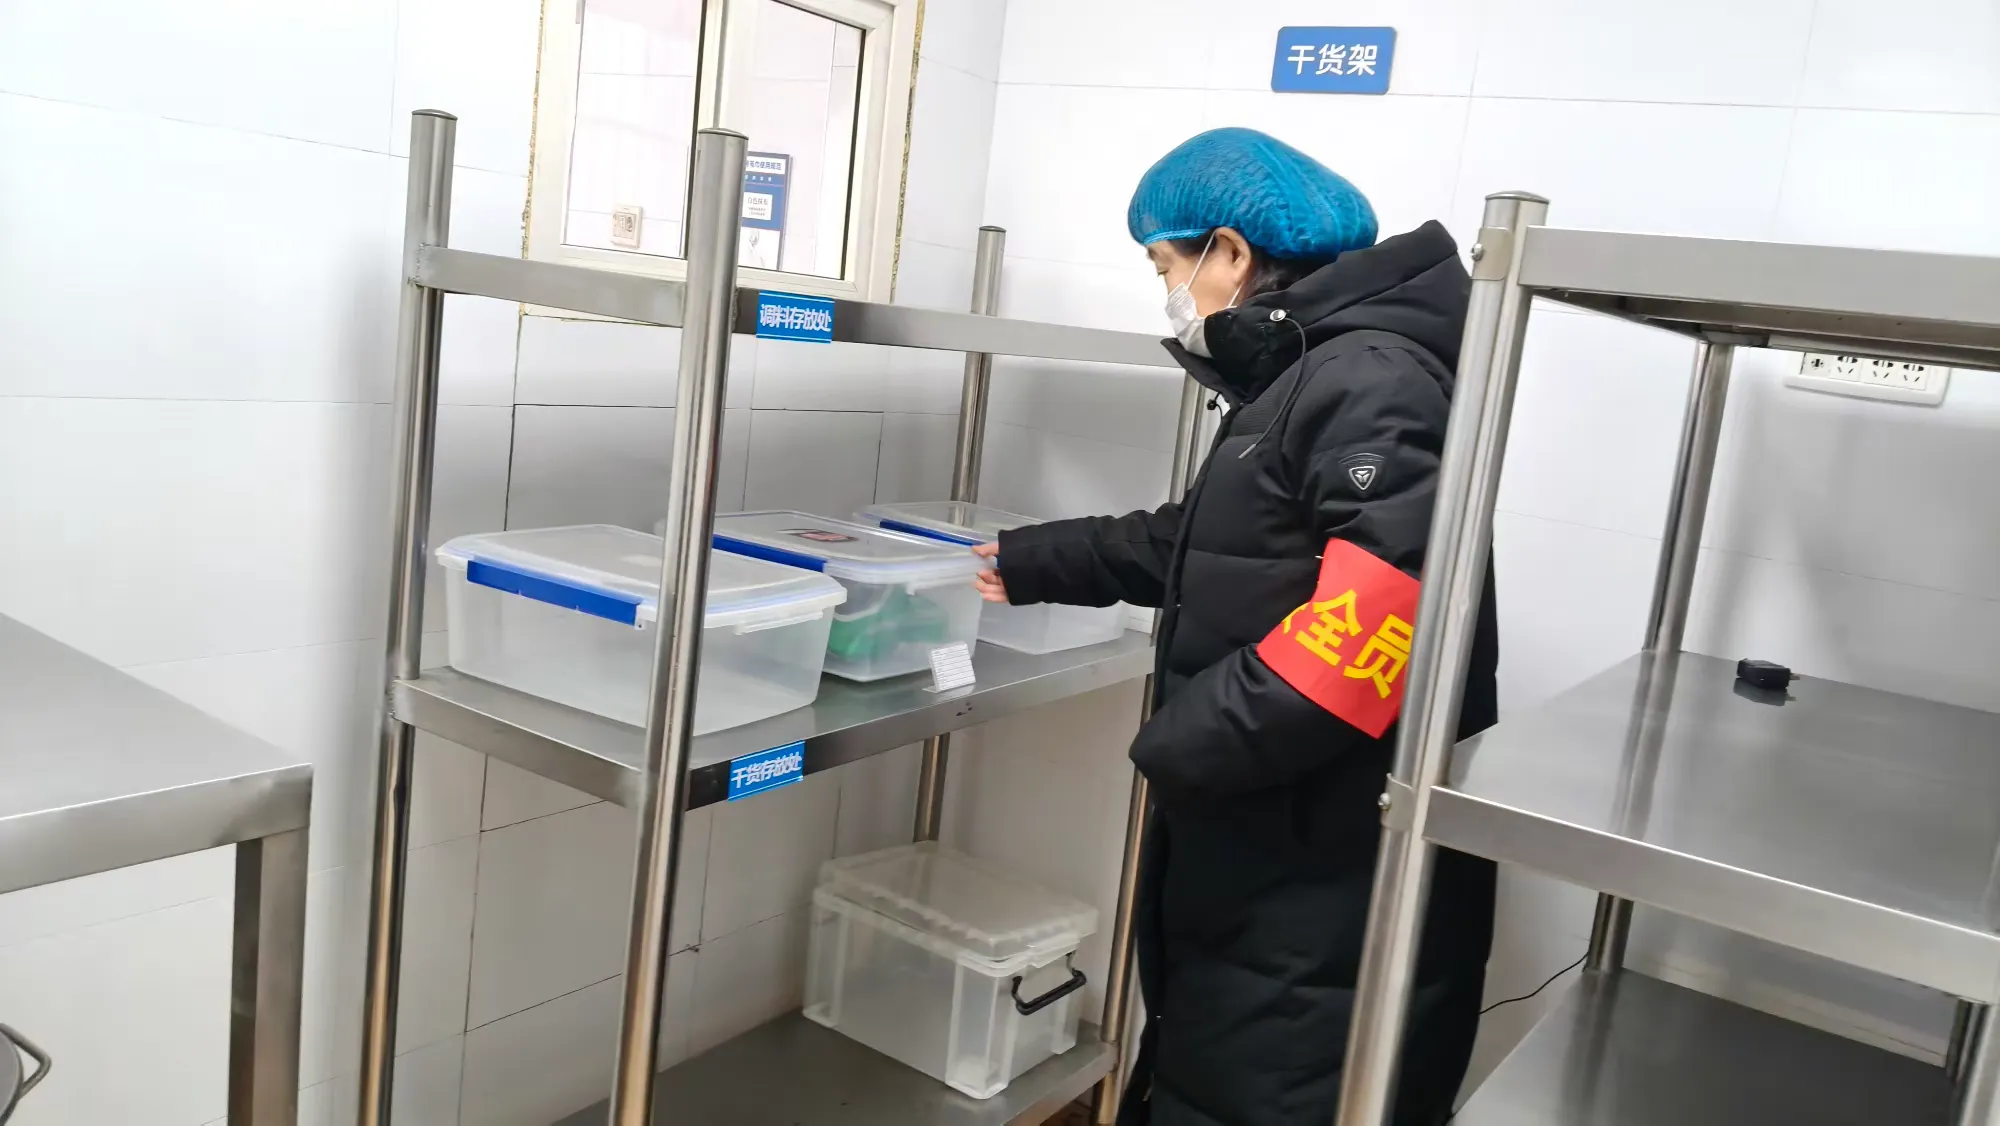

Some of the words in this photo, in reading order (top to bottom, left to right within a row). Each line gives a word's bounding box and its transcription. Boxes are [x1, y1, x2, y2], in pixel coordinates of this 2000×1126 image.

[1287, 43, 1378, 76] 干货架
[760, 303, 832, 333] 调料存放处
[731, 751, 803, 789] 干货存放处
